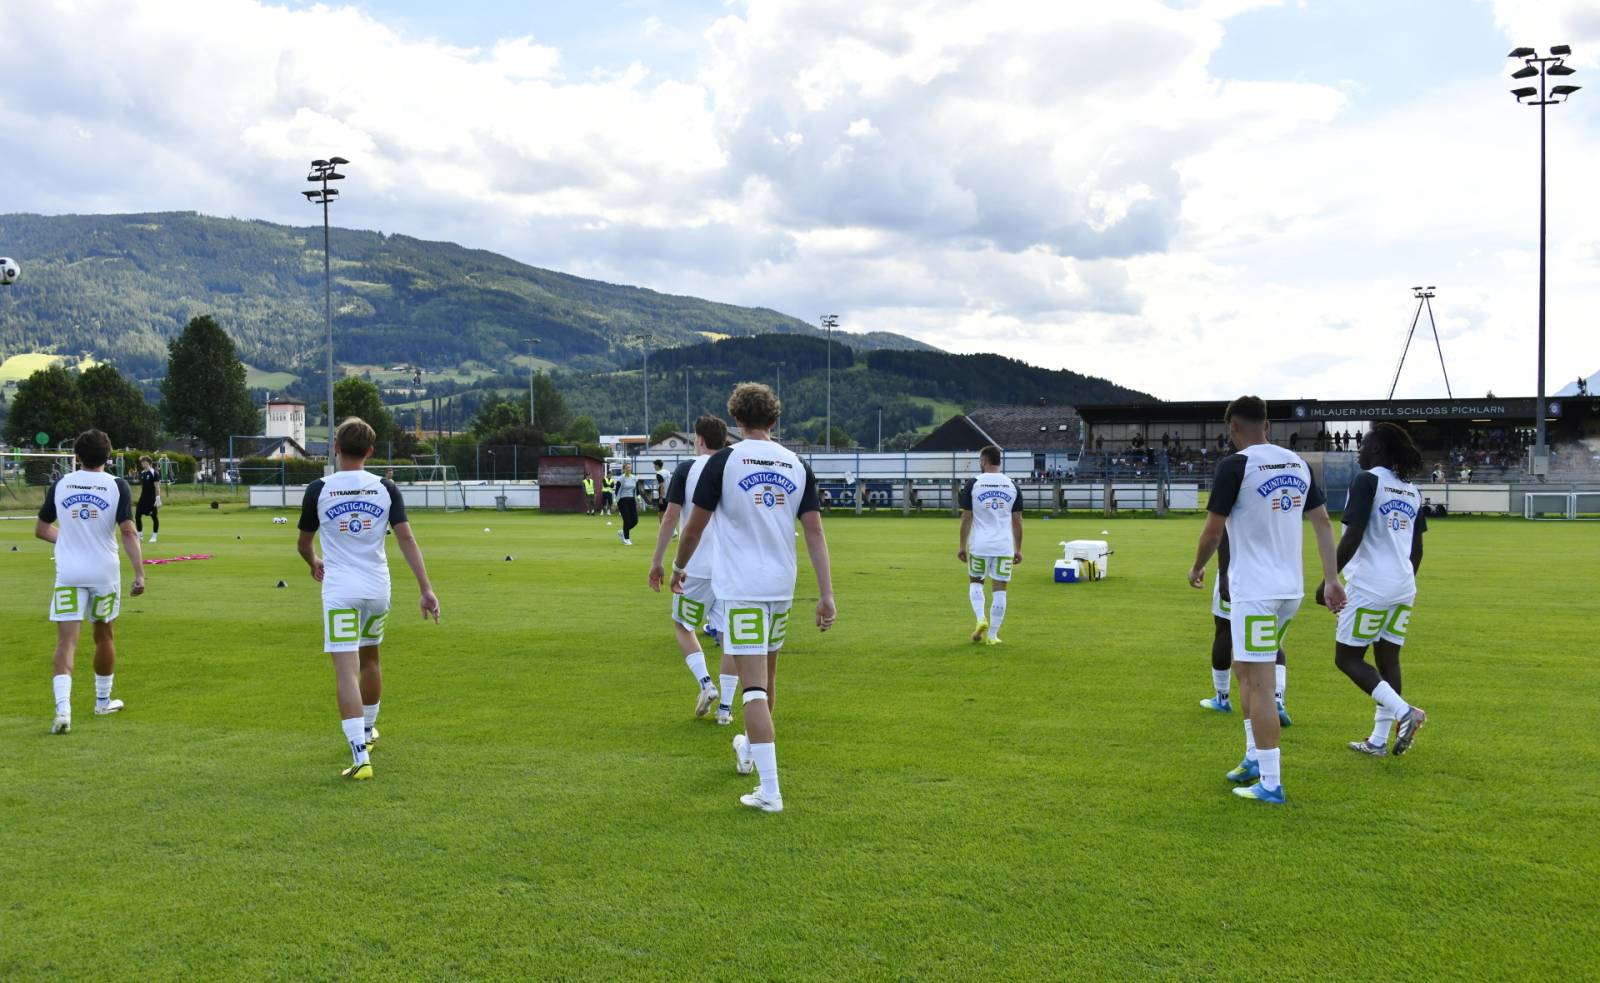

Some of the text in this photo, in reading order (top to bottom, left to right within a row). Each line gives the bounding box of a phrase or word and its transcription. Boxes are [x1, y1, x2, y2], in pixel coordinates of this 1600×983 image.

[1310, 405, 1505, 417] IMLAUER HOTEL SCHLOSS PICHLARN
[741, 472, 794, 494] PUNTIGAMER
[1260, 475, 1307, 496] PUNTIGAMER
[63, 494, 108, 509] PUNTIGAMER
[327, 501, 382, 518] PUNTIGAMER
[333, 613, 357, 638] E
[732, 612, 760, 640] E
[1250, 620, 1276, 647] E
[1358, 612, 1385, 635] E
